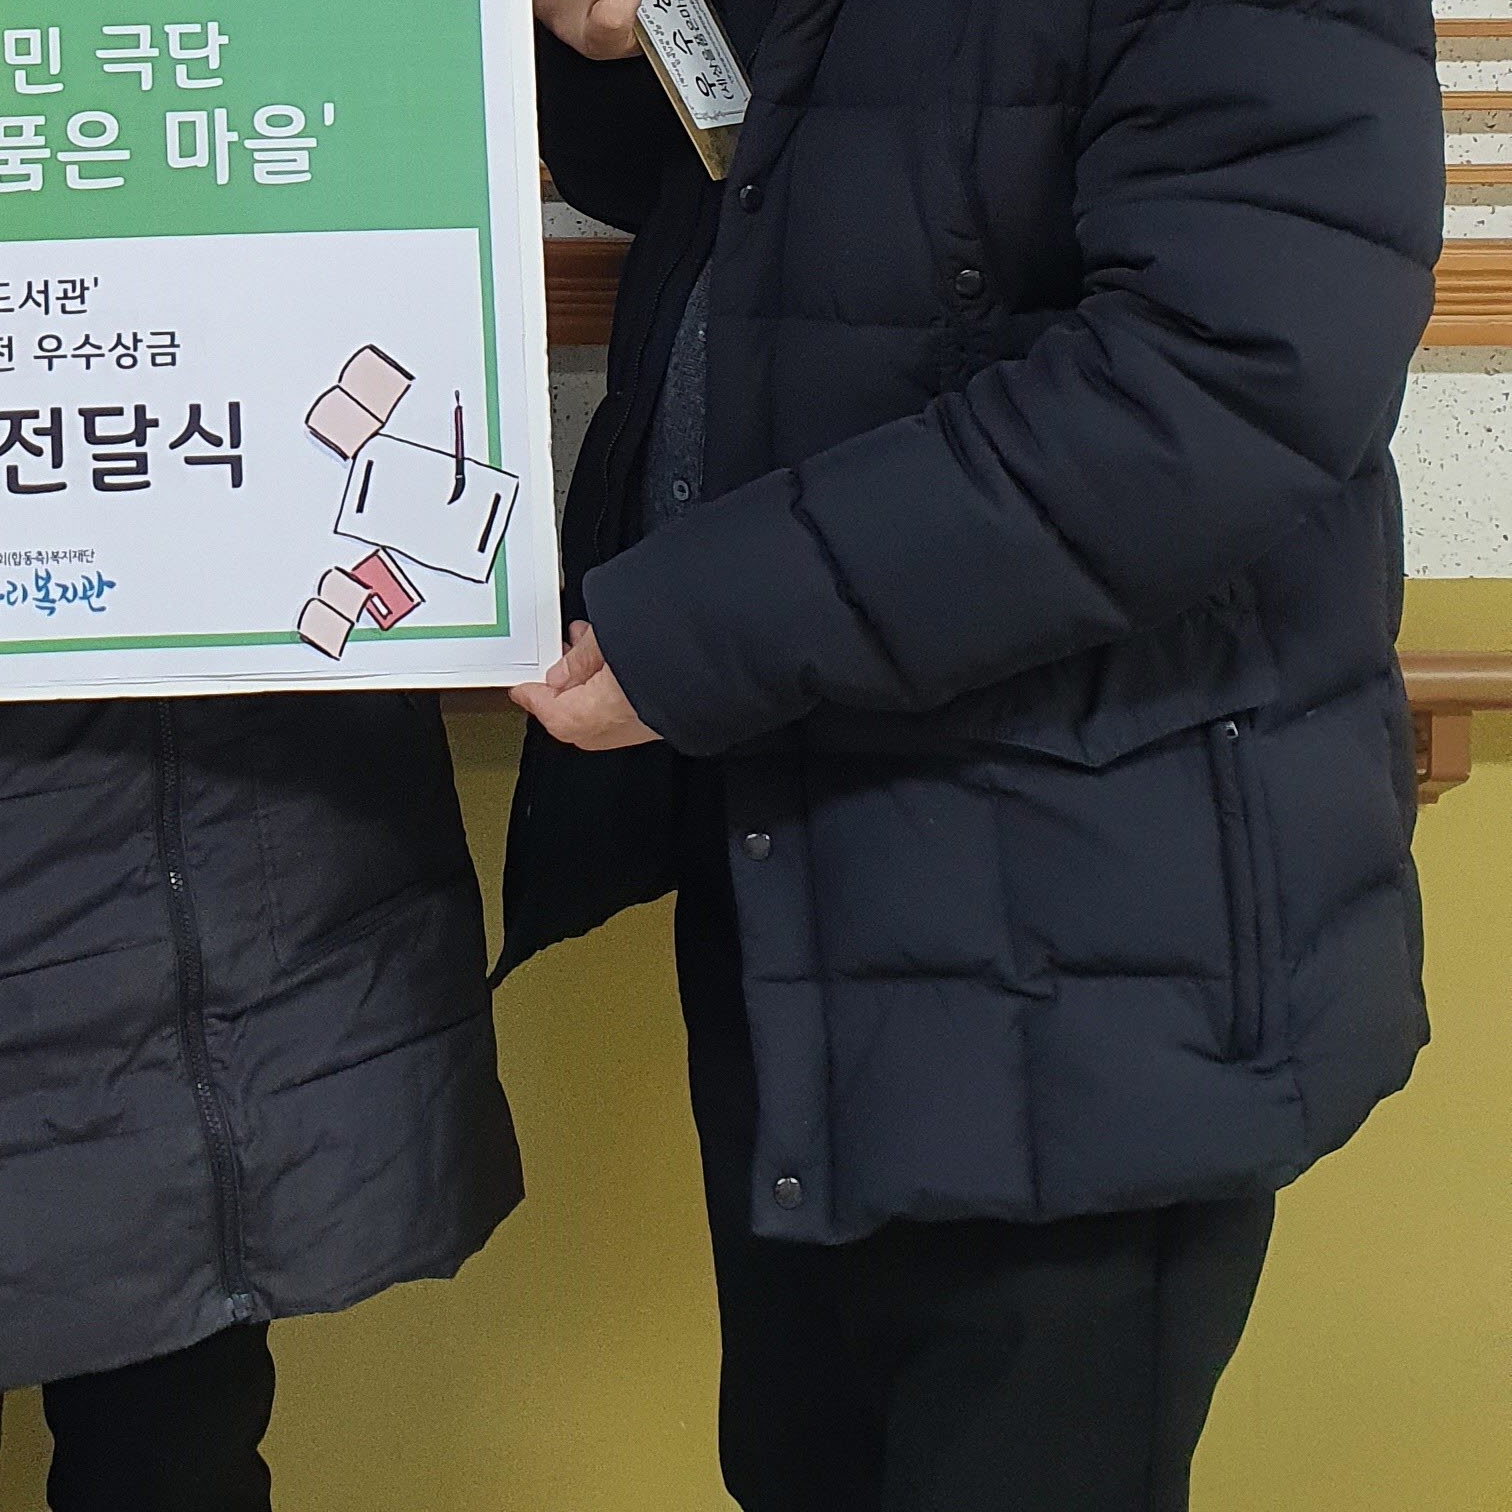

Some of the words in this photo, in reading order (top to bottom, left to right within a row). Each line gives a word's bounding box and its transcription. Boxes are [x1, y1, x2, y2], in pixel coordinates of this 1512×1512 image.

[93, 20, 231, 92] 극단
[164, 101, 337, 186] 마을'
[32, 330, 182, 372] 우수상금
